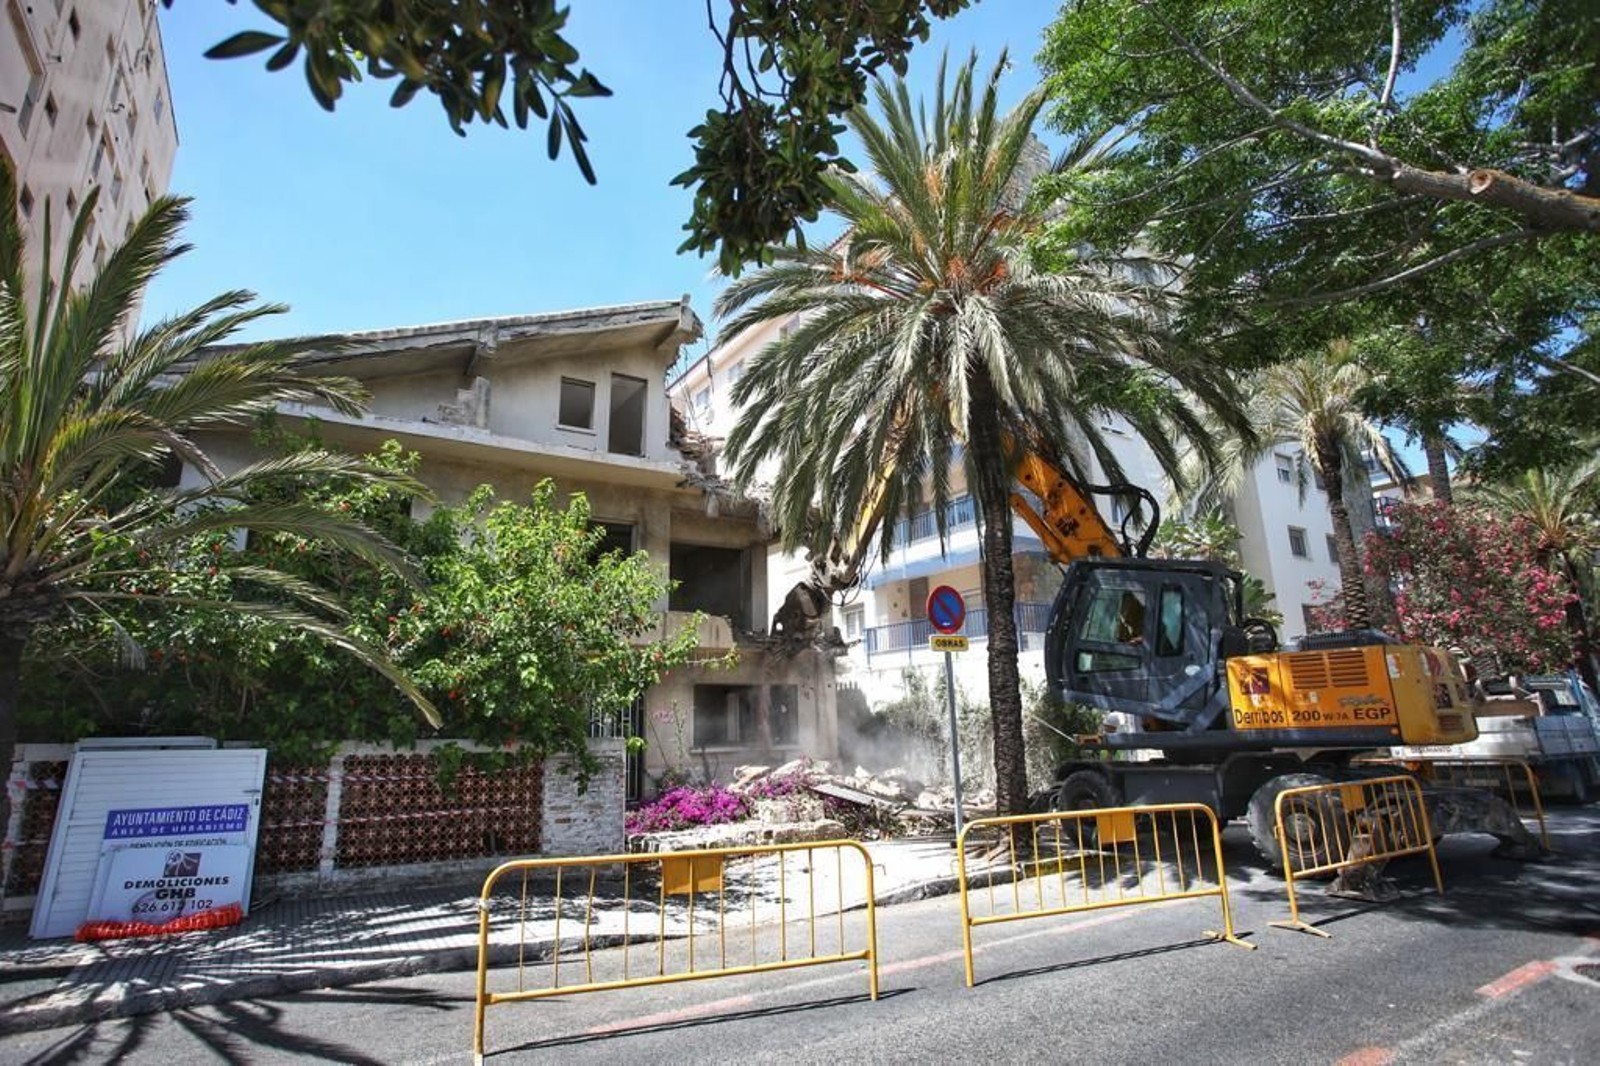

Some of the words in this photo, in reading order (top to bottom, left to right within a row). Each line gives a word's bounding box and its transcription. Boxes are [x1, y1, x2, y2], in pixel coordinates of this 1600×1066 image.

[935, 638, 965, 648] OBRAS
[1234, 709, 1284, 724] Derribos
[1292, 710, 1322, 721] 200
[1353, 707, 1391, 720] EGP
[113, 810, 196, 826] AYUNTAMIENTO
[198, 808, 212, 822] DE
[213, 805, 244, 821] CÁDIZ
[151, 826, 165, 834] DE
[172, 822, 243, 833] URBANISMO
[124, 876, 230, 890] DEMOLICIONES
[155, 887, 196, 900] GHB
[131, 903, 157, 914] 626
[191, 899, 213, 910] 102
